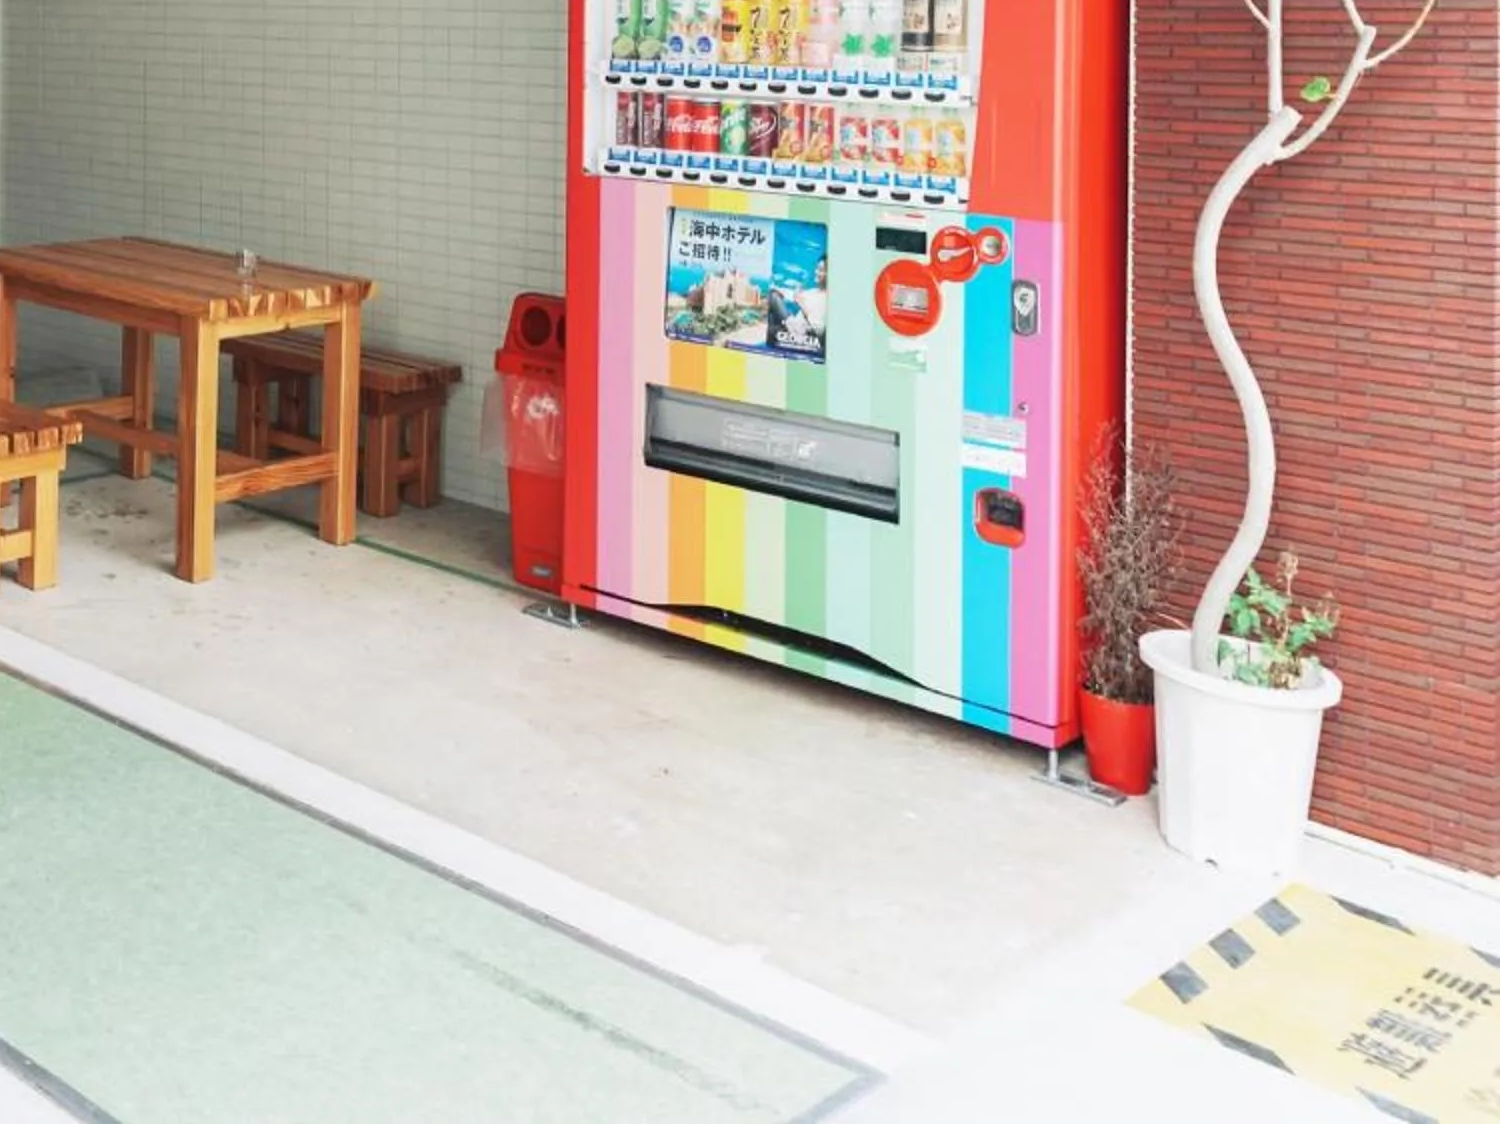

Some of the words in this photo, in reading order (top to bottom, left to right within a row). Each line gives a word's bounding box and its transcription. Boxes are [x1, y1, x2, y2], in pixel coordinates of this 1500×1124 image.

[689, 219, 766, 245] 海中ホテル
